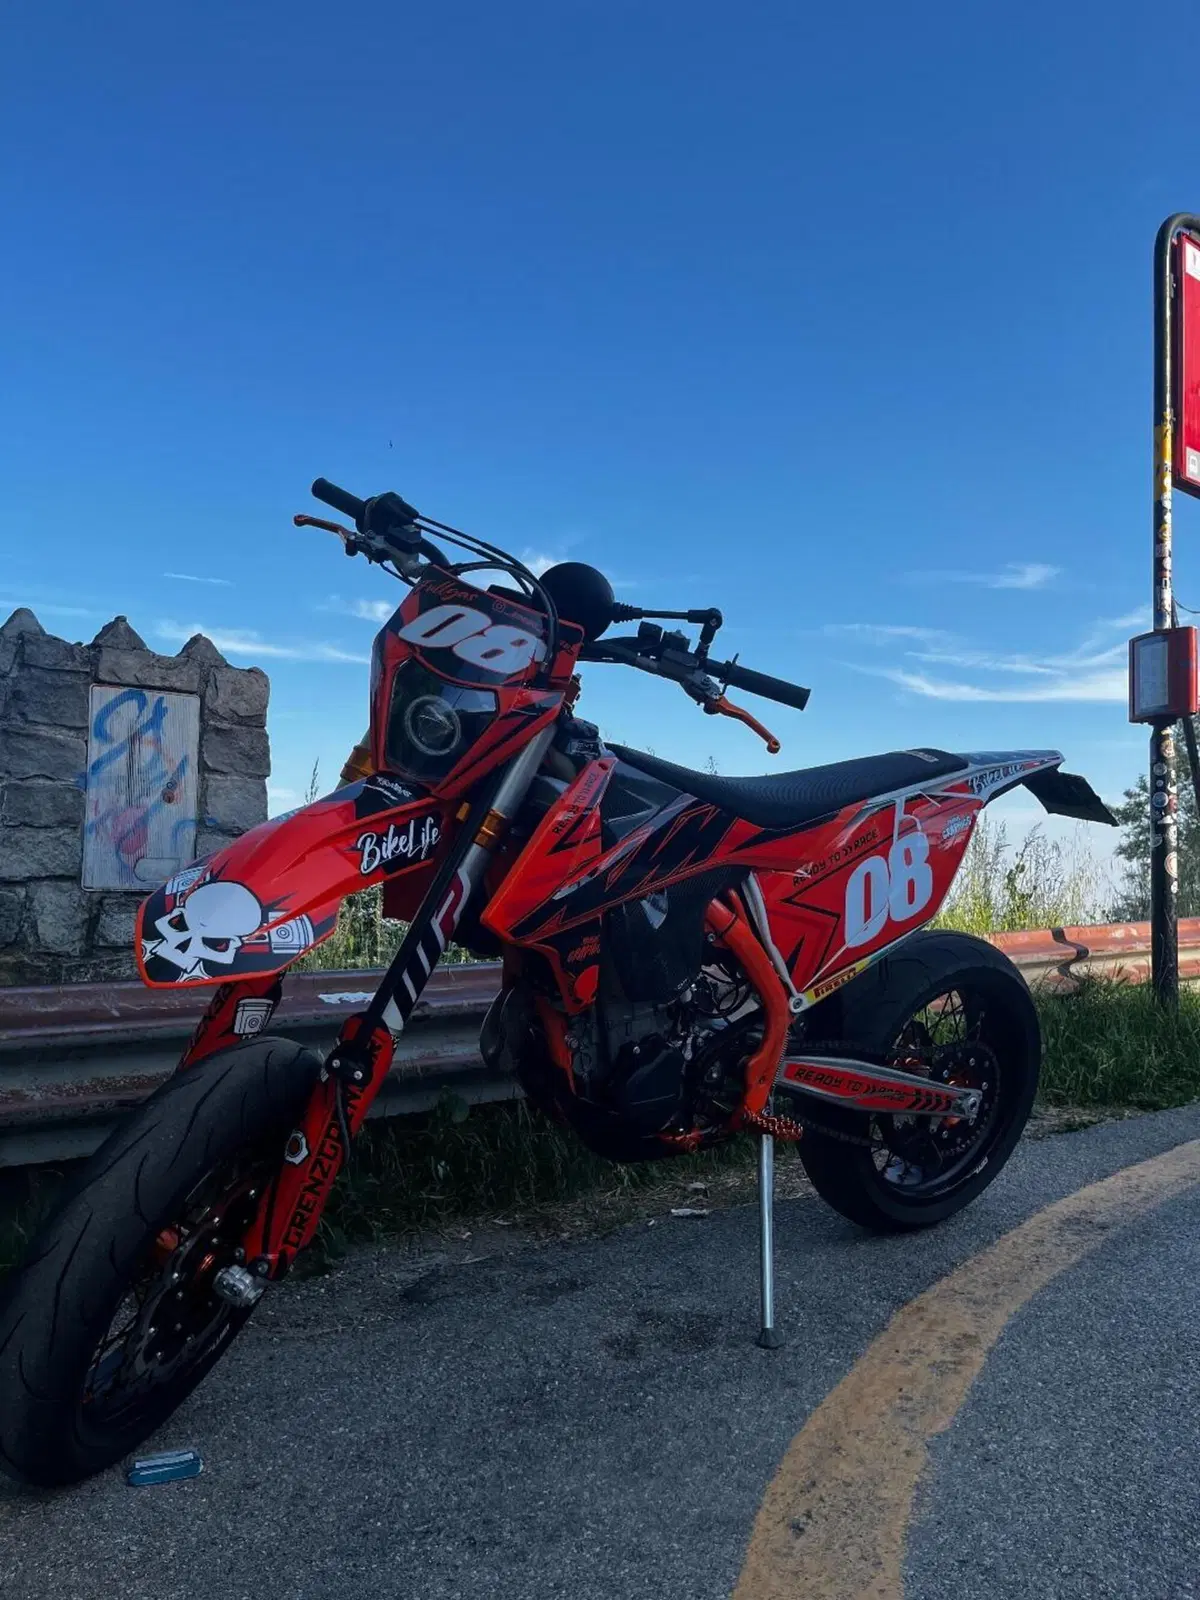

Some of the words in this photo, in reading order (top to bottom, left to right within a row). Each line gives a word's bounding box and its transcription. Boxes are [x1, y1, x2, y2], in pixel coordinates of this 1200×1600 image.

[398, 604, 547, 674] 08
[845, 831, 933, 948] 08
[794, 1068, 843, 1088] READY
[845, 1079, 862, 1093] TO
